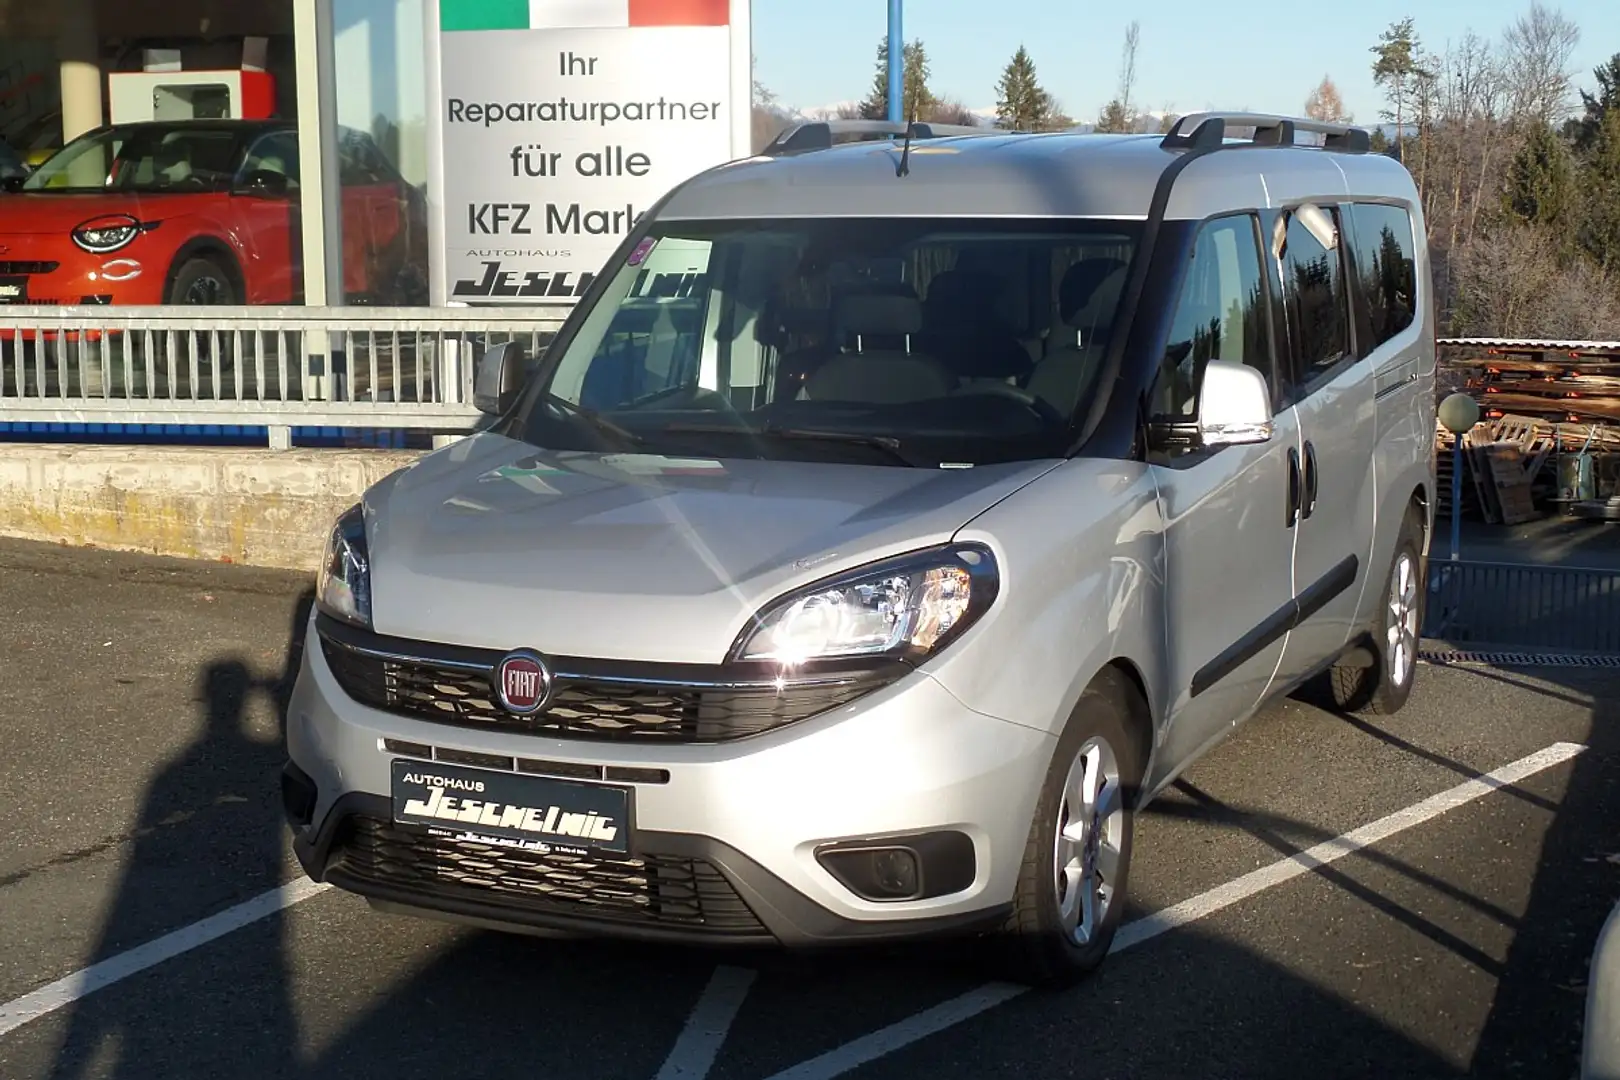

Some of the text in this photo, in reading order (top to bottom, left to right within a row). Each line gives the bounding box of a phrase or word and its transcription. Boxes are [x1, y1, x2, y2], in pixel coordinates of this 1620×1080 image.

[559, 51, 598, 76] Ihr
[448, 97, 721, 127] Reparaturpartner
[510, 145, 652, 177] für alle
[468, 203, 532, 235] KFZ
[466, 249, 572, 258] AUTOHAUS
[508, 669, 538, 698] FIAT
[402, 772, 485, 793] AUTOHAUS
